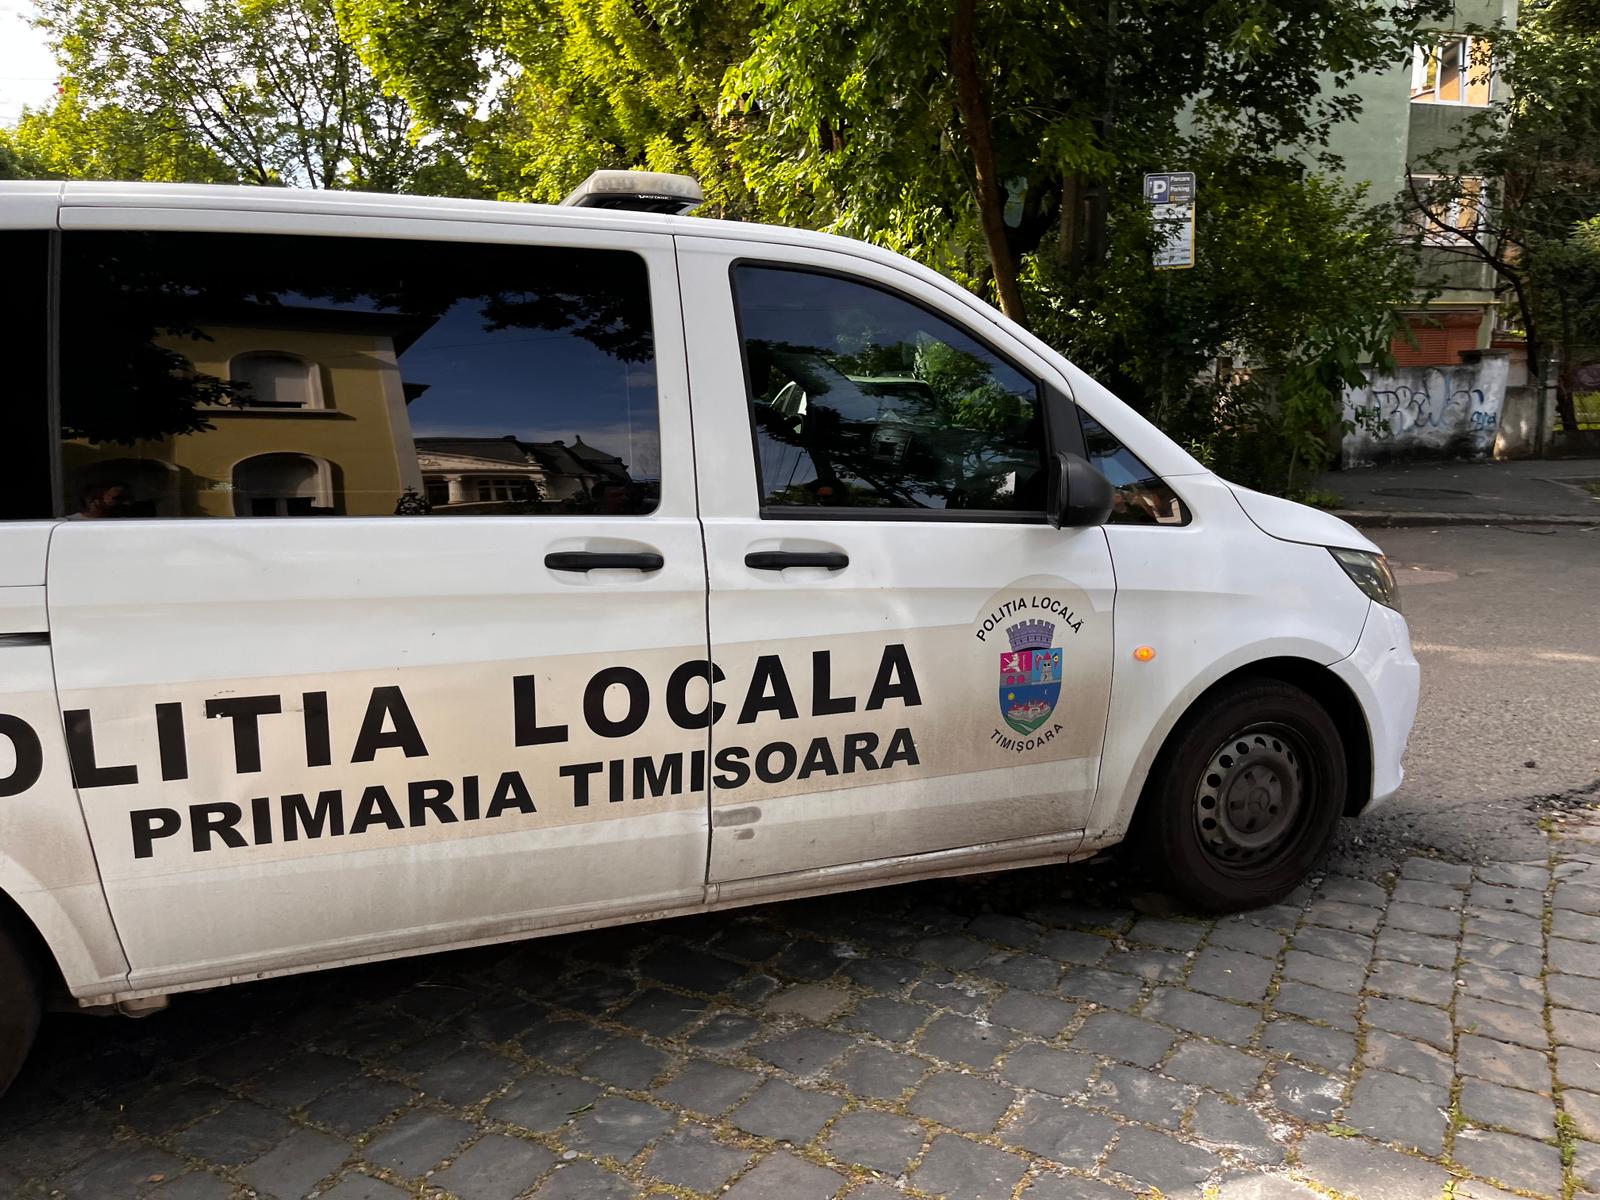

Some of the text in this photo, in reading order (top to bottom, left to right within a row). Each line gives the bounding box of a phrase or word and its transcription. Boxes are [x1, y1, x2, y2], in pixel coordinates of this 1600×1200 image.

[1153, 180, 1167, 194] P
[1032, 596, 1084, 634] LOCALĂ
[513, 644, 922, 747] LOCALA
[130, 727, 921, 858] PRIMARIA TIMISOARA
